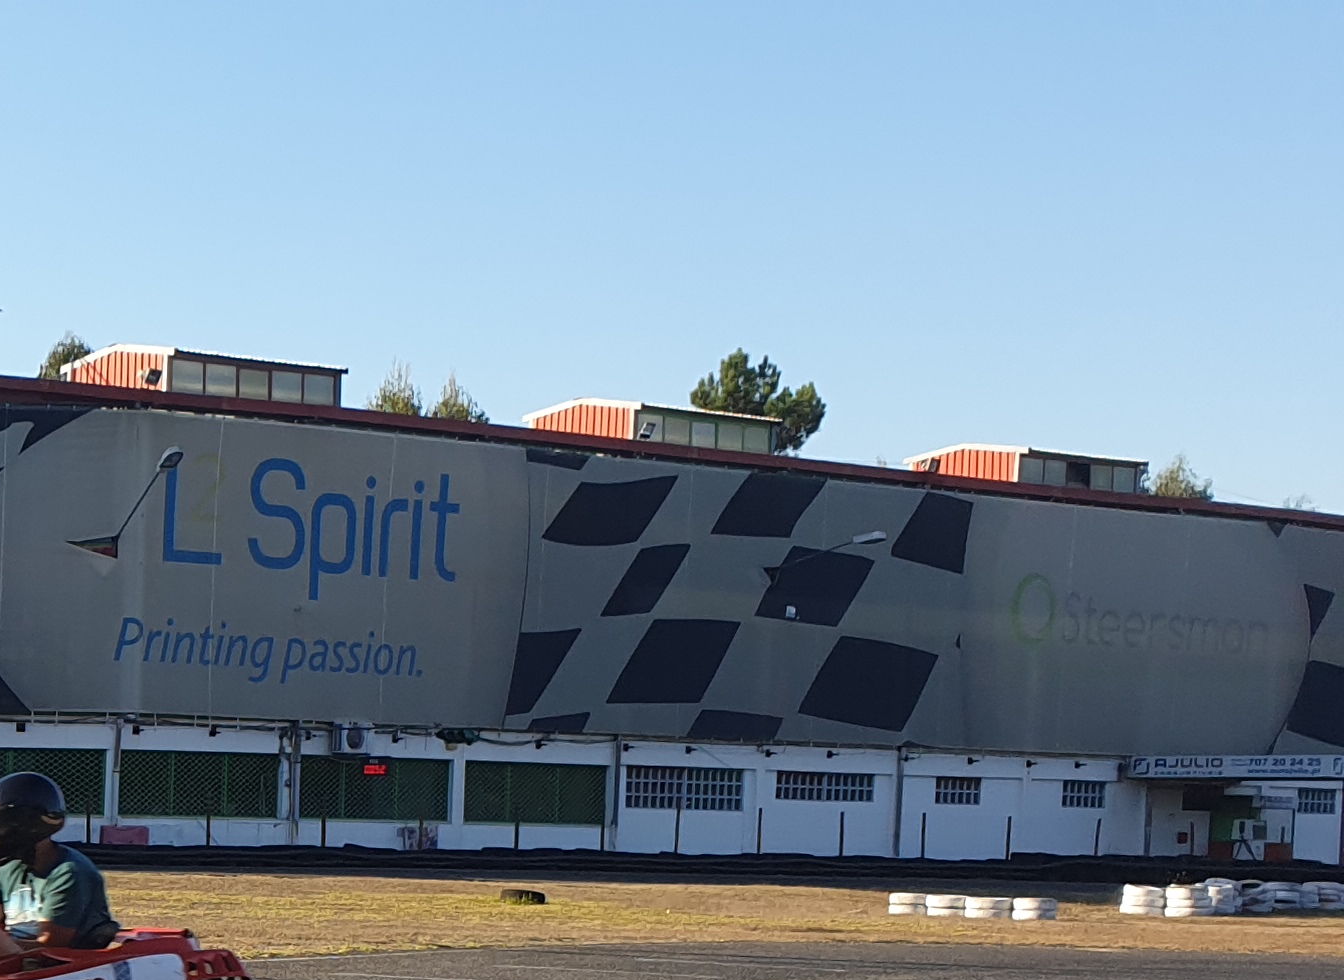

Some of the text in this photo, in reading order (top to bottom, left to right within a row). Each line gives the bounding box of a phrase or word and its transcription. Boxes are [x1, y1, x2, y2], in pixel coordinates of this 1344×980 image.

[246, 456, 461, 601] Spirit
[113, 616, 424, 685] Printing passion.
[1248, 757, 1268, 767] 707
[1272, 757, 1286, 767] 20
